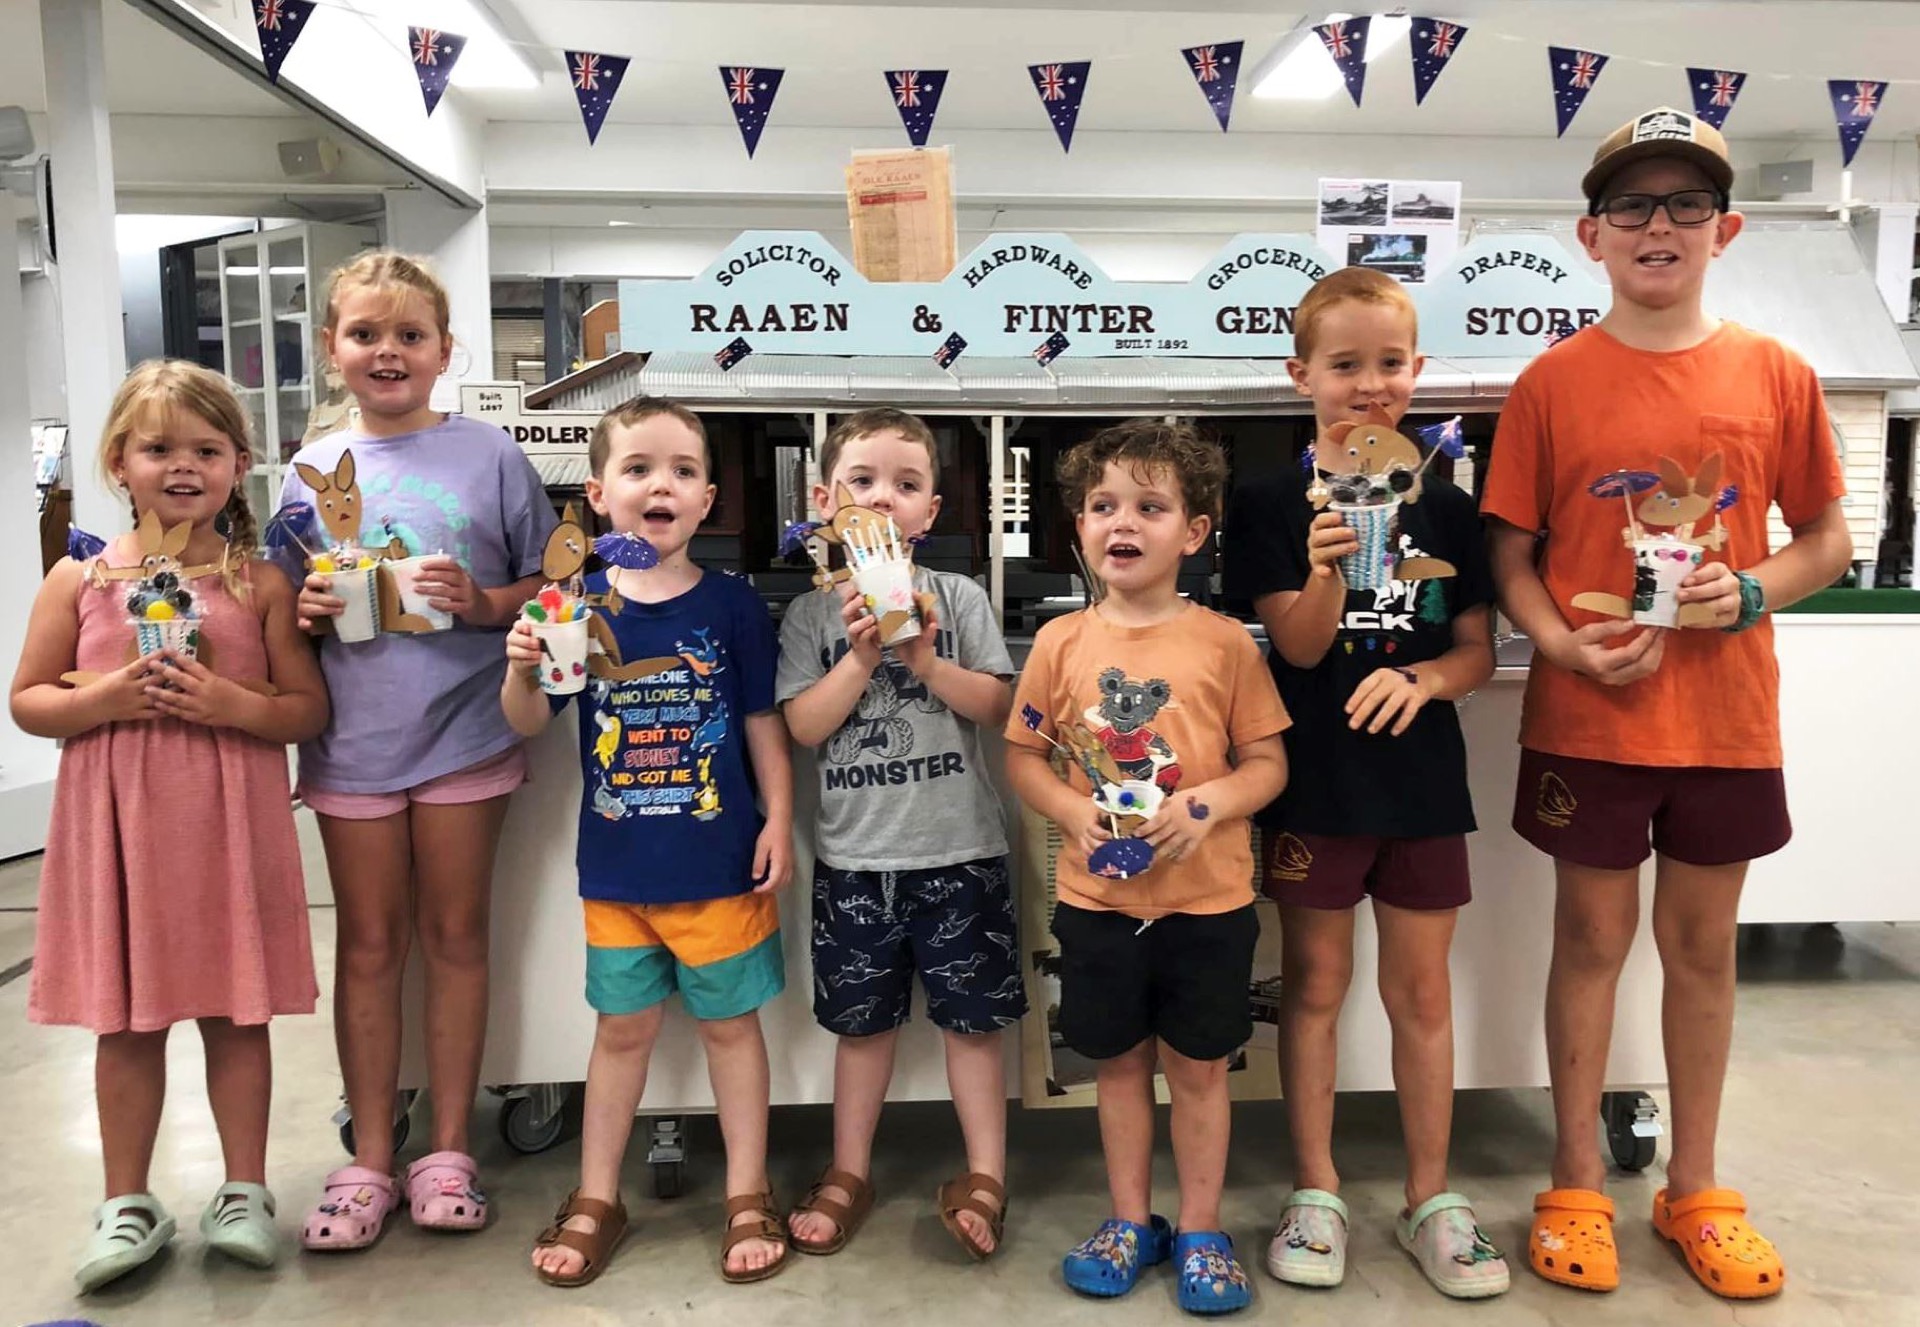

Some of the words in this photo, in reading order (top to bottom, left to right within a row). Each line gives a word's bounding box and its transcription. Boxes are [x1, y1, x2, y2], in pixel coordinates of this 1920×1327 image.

[716, 245, 842, 287] SOLICITOR
[963, 245, 1093, 290] HARDWARE
[1207, 248, 1326, 290] GROCERIE
[1458, 251, 1567, 284] DRAPERY
[690, 304, 849, 332] RAAEN
[912, 304, 942, 333] &
[1003, 304, 1155, 333] FINTER
[1216, 306, 1298, 334] GEN
[1115, 339, 1152, 349] BUILT
[1157, 340, 1188, 349] 1892
[502, 426, 593, 444] DDLER
[1337, 611, 1414, 632] CK
[610, 690, 641, 705] WHO
[644, 688, 690, 703] LOVES
[694, 687, 713, 702] ME
[628, 729, 666, 744] WENT
[670, 728, 691, 741] TO
[637, 770, 668, 784] GOT
[671, 769, 693, 783] ME
[826, 751, 966, 791] MONSTER
